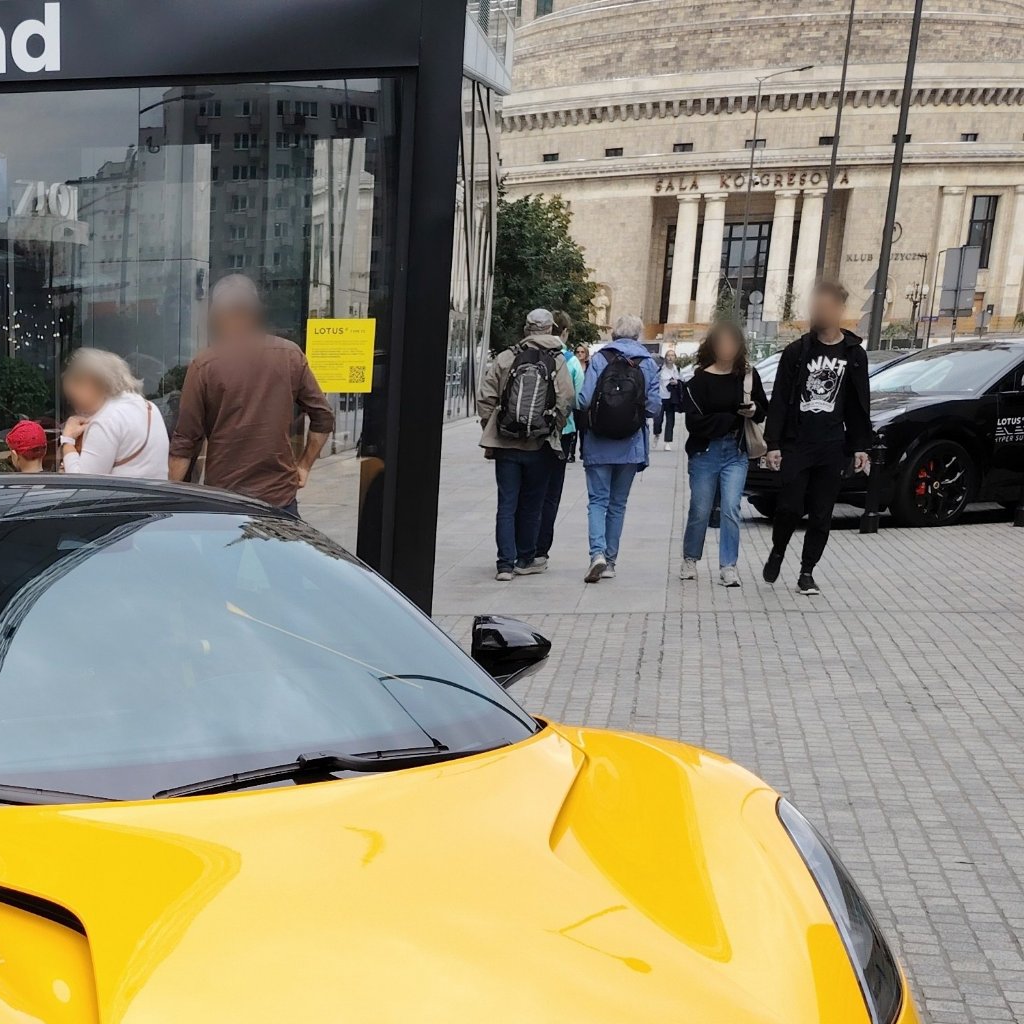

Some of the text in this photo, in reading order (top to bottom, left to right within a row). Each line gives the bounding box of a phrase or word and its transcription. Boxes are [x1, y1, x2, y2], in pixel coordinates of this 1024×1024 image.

[655, 178, 699, 193] SALA
[314, 327, 344, 335] LOTUS
[997, 417, 1021, 426] LOTUS
